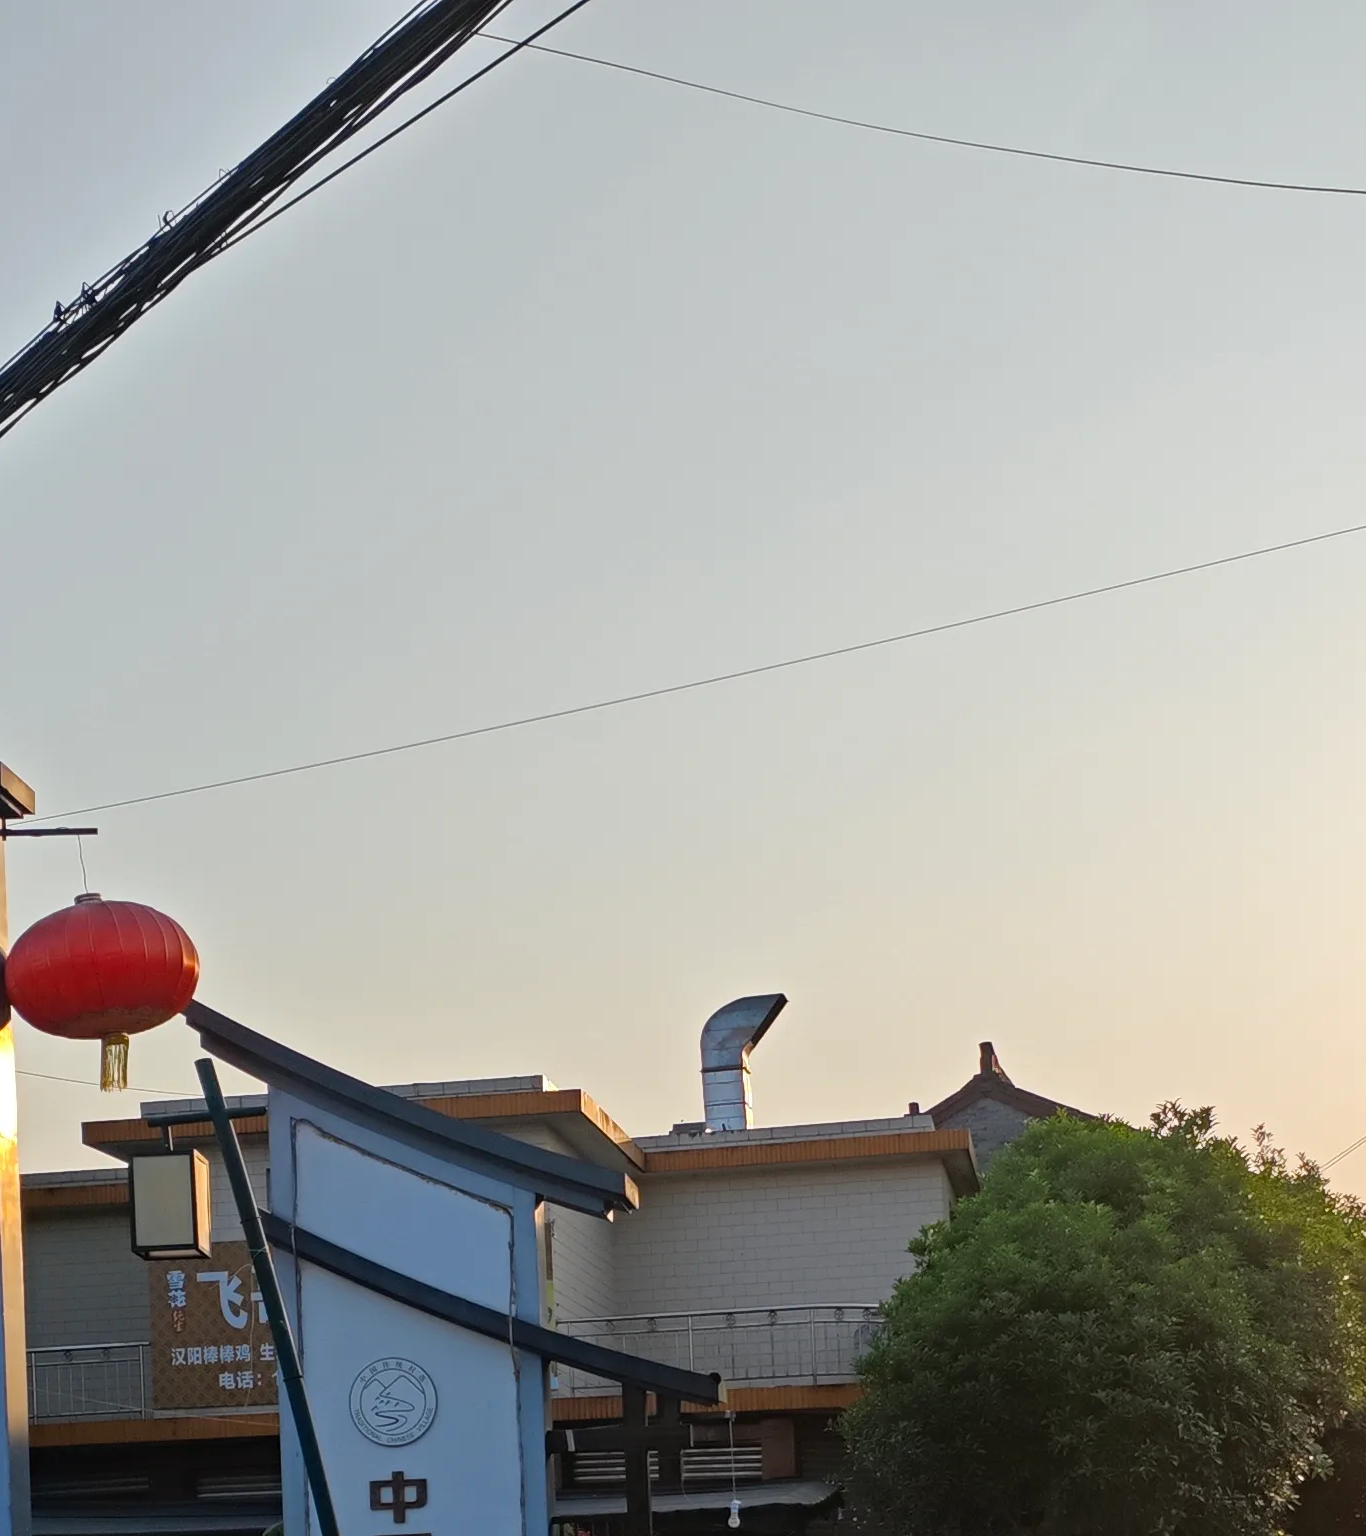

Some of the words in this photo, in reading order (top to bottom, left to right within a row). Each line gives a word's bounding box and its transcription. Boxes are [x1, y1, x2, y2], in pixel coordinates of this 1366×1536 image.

[171, 1344, 251, 1366] 汉阳棒棒鸡
